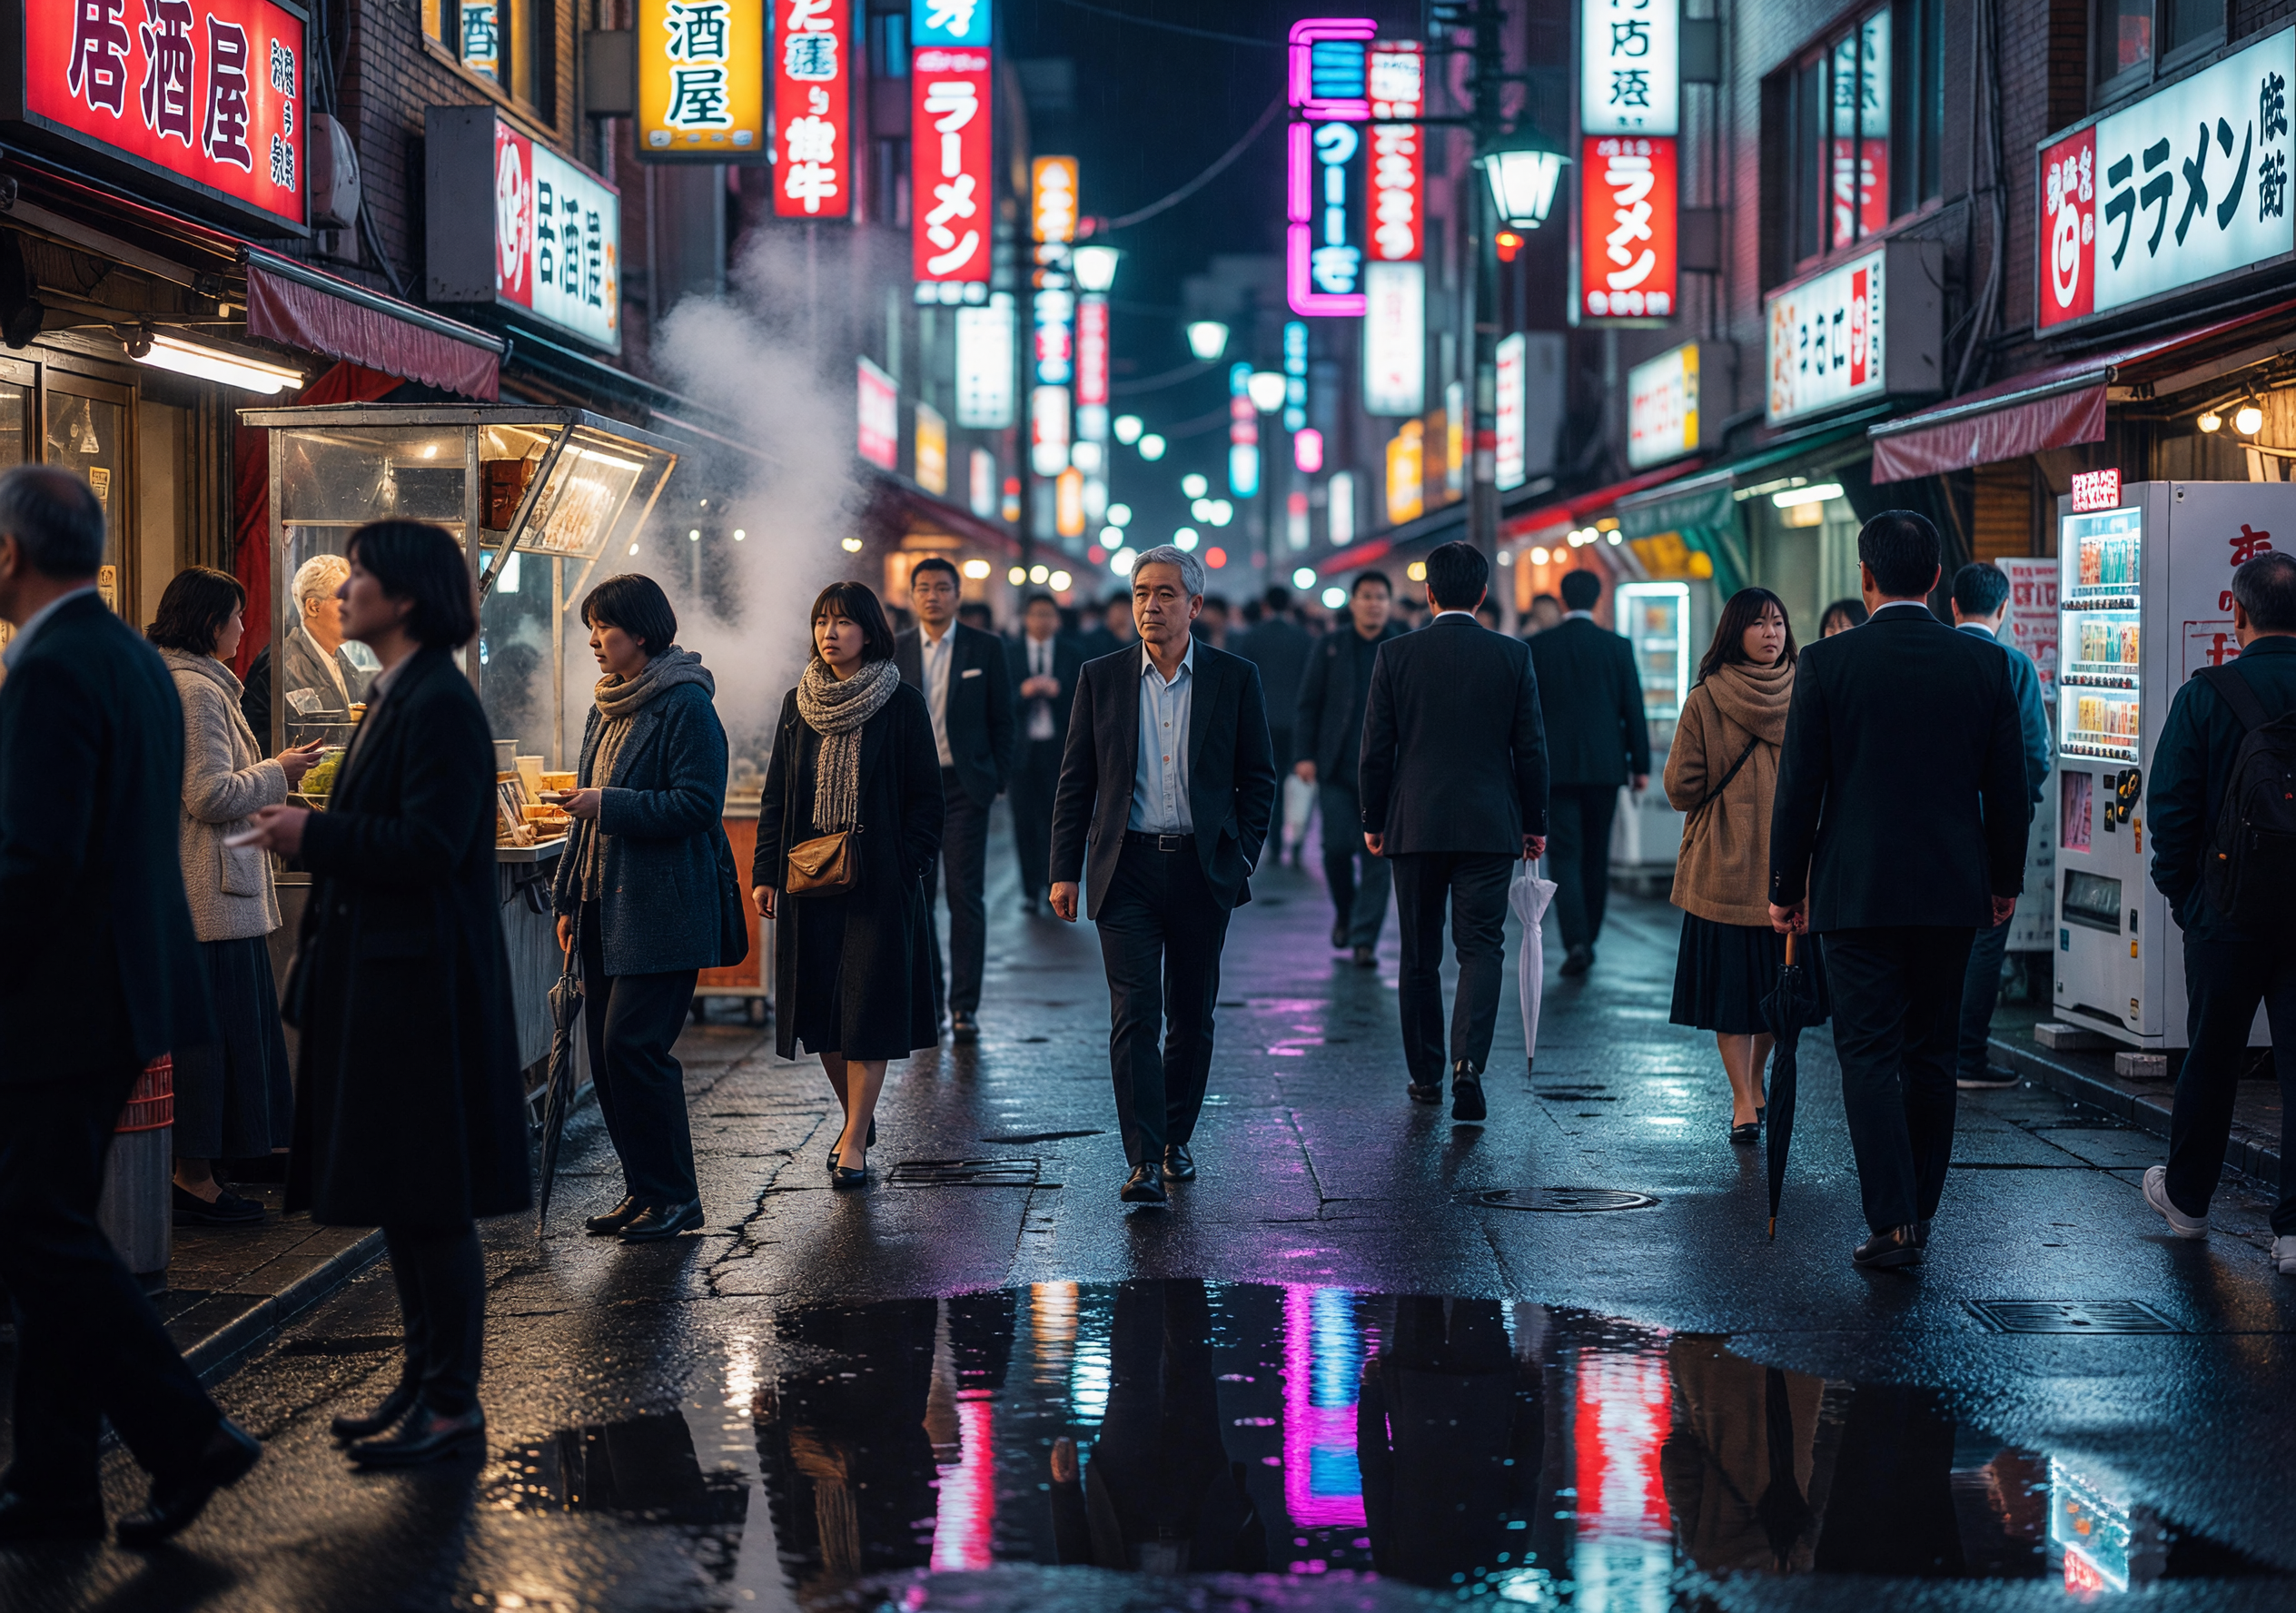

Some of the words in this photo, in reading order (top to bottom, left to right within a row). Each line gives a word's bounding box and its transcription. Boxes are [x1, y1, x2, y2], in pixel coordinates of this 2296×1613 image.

[67, 0, 252, 173] 居酒屋
[664, 1, 733, 130] 酒屋
[924, 81, 979, 276] ラーメン
[1604, 152, 1656, 291] ラメン
[2104, 116, 2252, 272] ララメン
